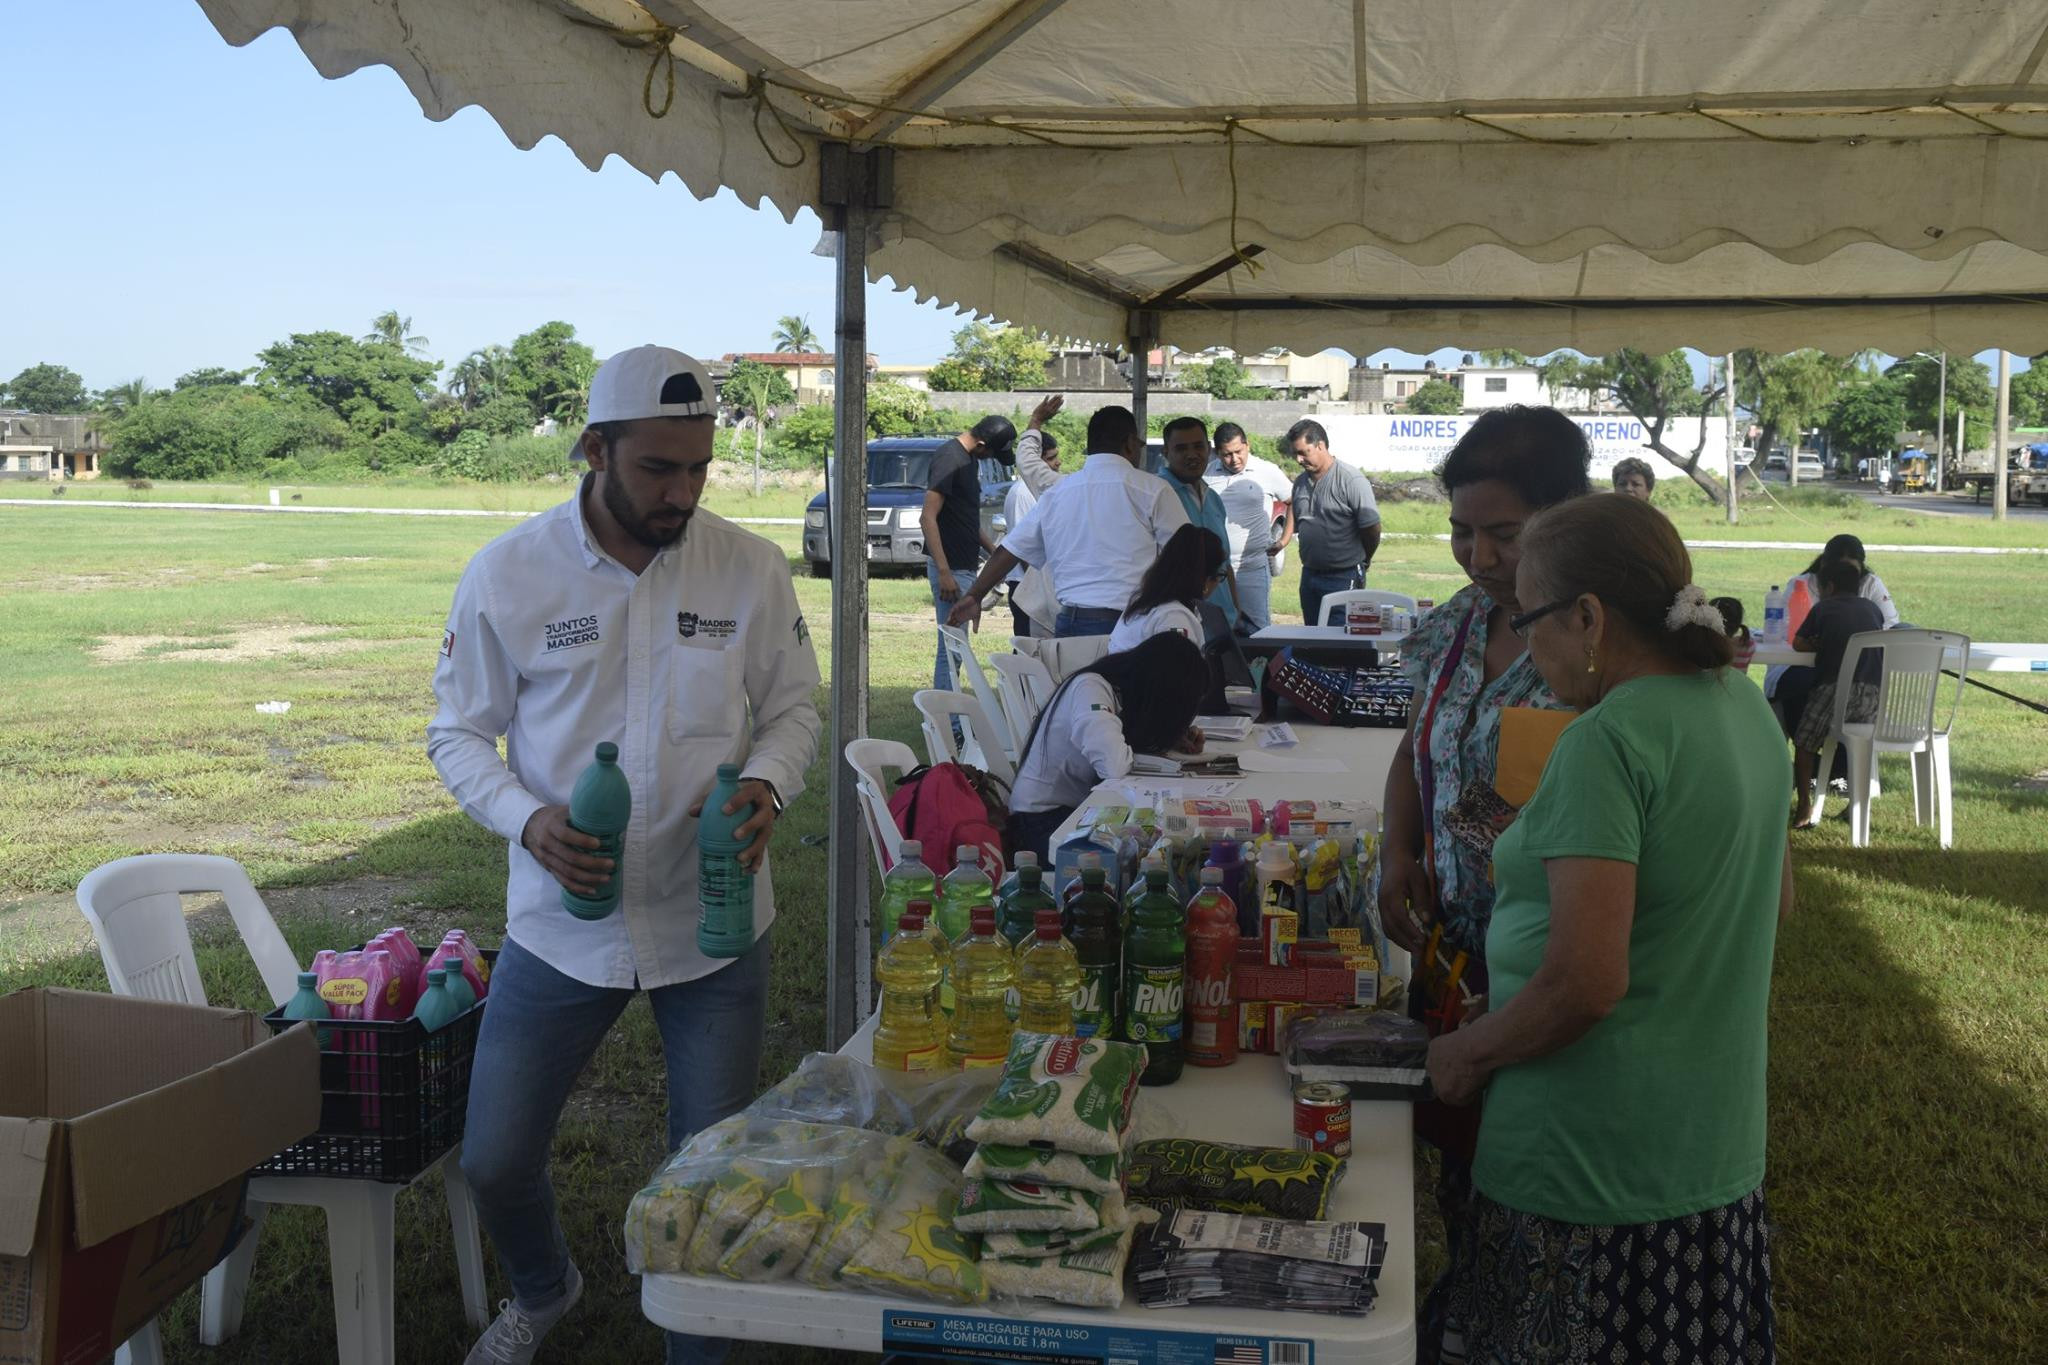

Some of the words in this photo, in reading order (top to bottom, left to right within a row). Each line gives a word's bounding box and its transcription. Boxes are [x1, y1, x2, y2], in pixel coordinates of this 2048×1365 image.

[1389, 420, 1457, 438] ANDRES
[1579, 422, 1642, 440] ORENO
[544, 615, 598, 635] JUNTOS
[698, 619, 737, 628] MADERO
[545, 625, 599, 641] TRANSFORMANDO
[547, 631, 600, 651] MADERO
[1330, 929, 1359, 938] PRECIO
[1342, 944, 1371, 954] PRECIO
[1345, 960, 1377, 970] PRECIO
[322, 990, 345, 998] VALUE
[345, 989, 365, 998] PACK
[896, 1319, 931, 1329] LIFETIME
[943, 1320, 973, 1330] MESA
[977, 1321, 1030, 1337] PLEGABLE
[1033, 1326, 1062, 1339] PARA
[1065, 1329, 1089, 1341] USO
[942, 1330, 1010, 1346] COMERCIAL
[1013, 1336, 1028, 1348] DE
